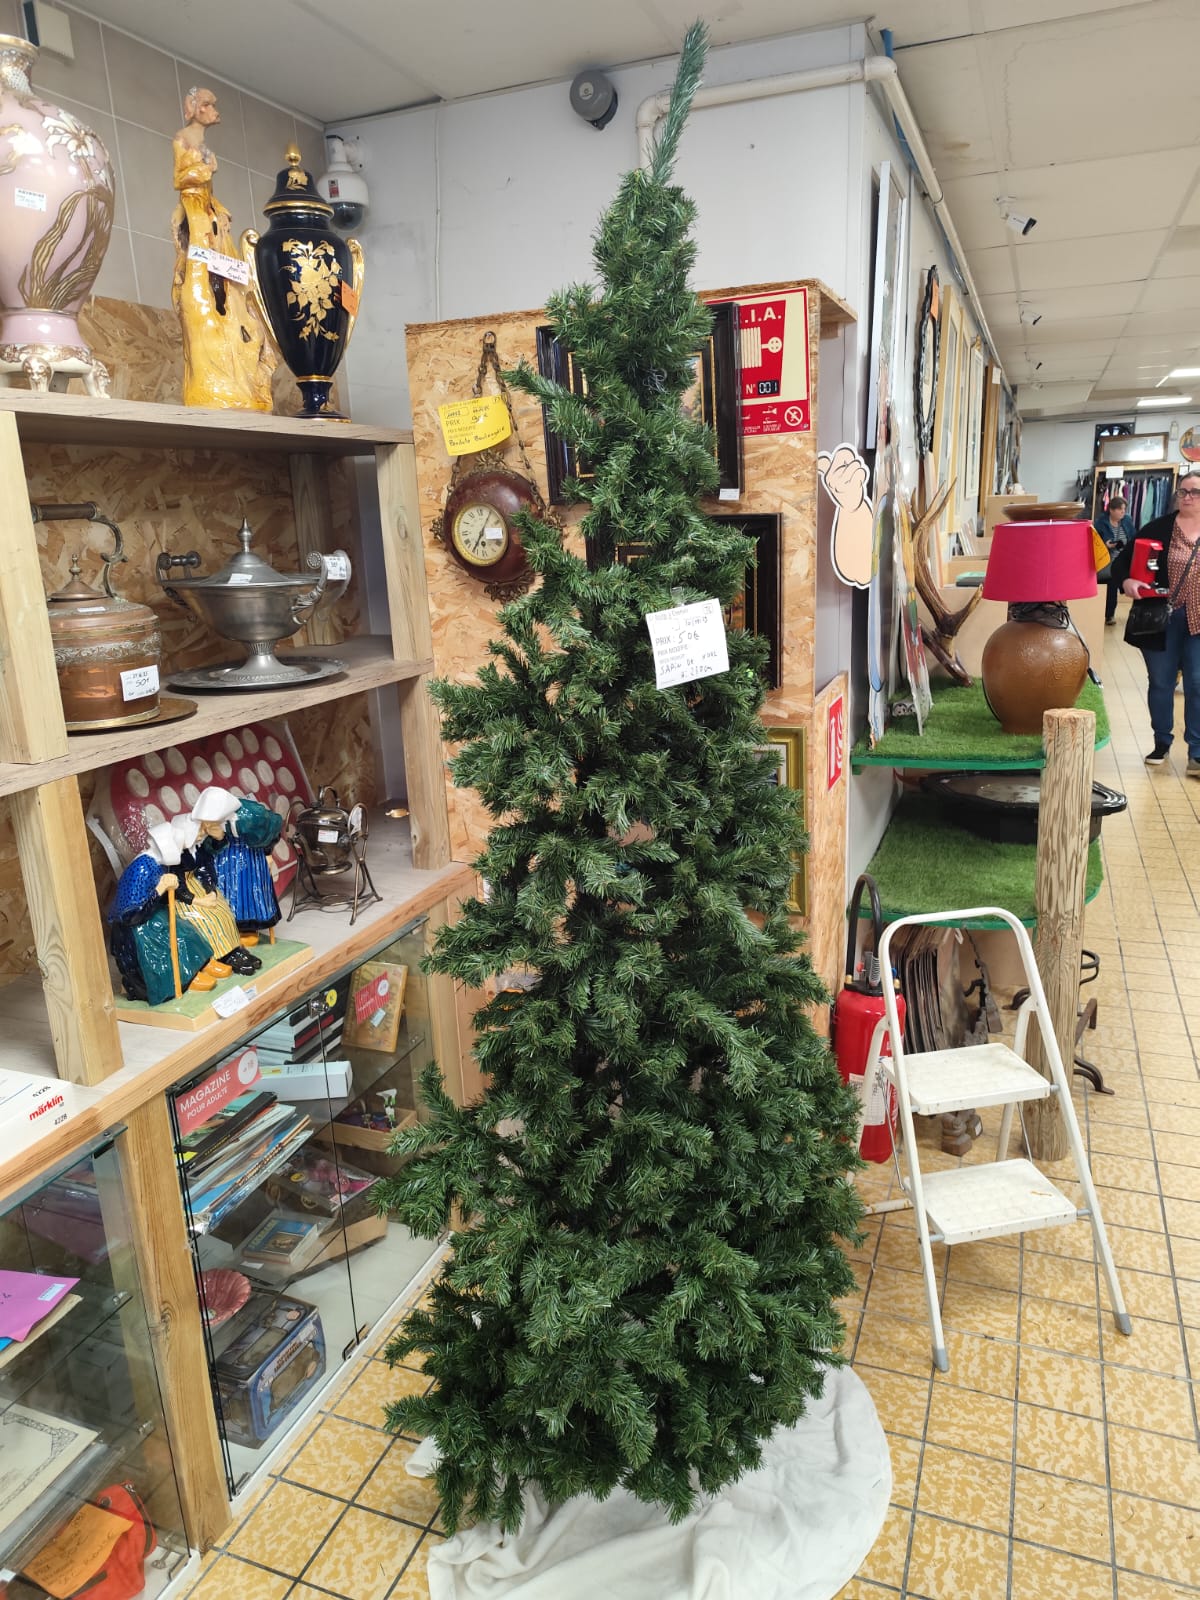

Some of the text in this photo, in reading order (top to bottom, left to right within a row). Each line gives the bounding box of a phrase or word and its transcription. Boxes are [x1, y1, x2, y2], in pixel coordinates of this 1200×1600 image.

[180, 1070, 231, 1113] MAGAZINE
[29, 1094, 64, 1121] märklin
[187, 1103, 206, 1121] POUR
